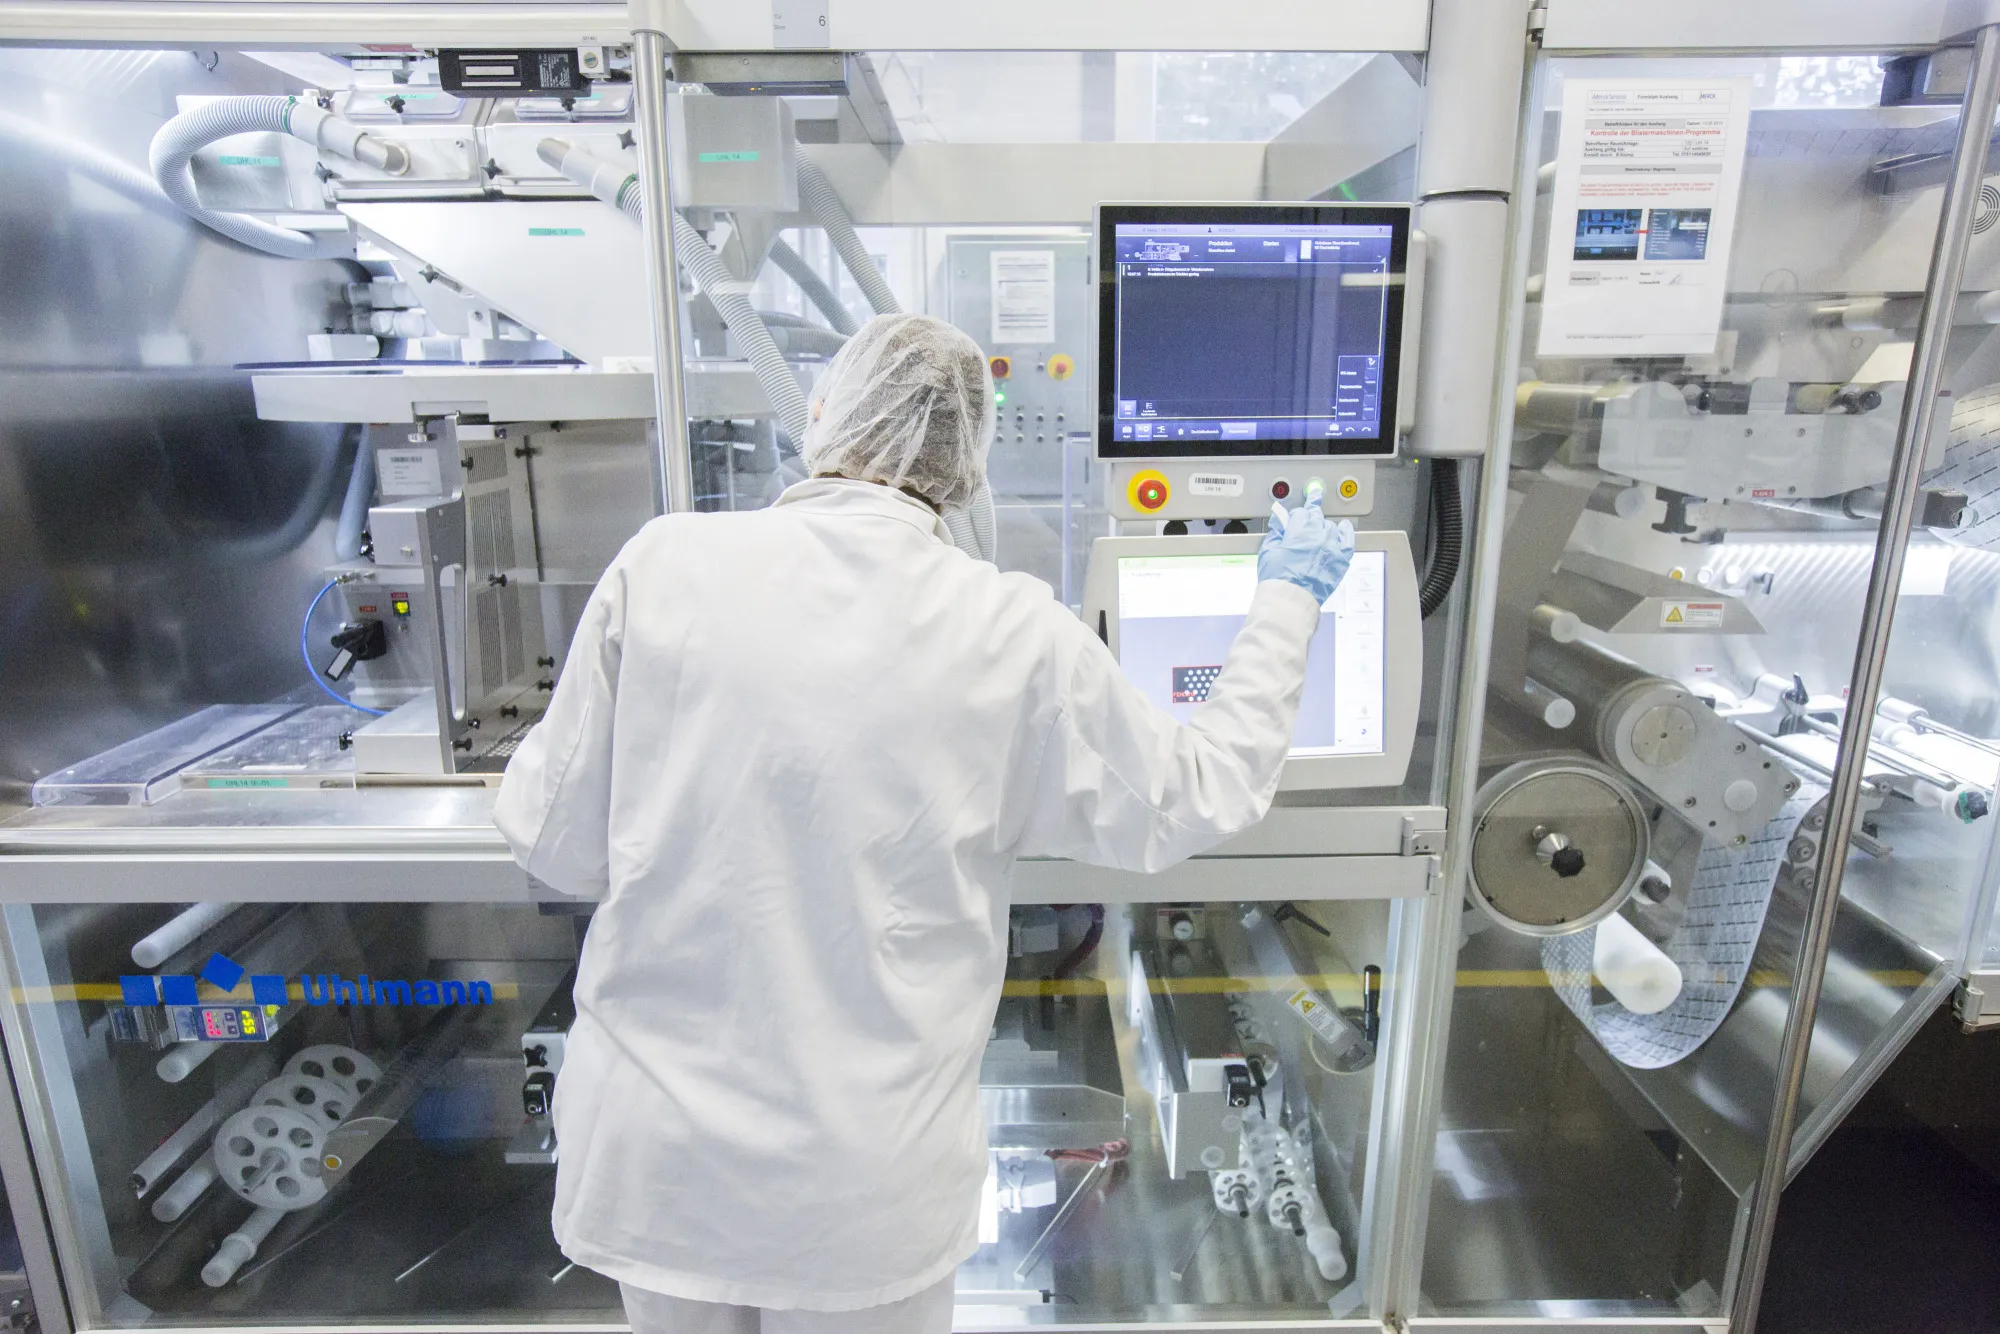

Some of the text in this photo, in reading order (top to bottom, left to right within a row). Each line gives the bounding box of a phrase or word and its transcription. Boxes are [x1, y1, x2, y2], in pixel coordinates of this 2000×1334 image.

[818, 15, 826, 27] 6
[1590, 129, 1619, 137] Kontrolle
[1345, 484, 1352, 493] C
[301, 974, 493, 1006] Uhlmann
